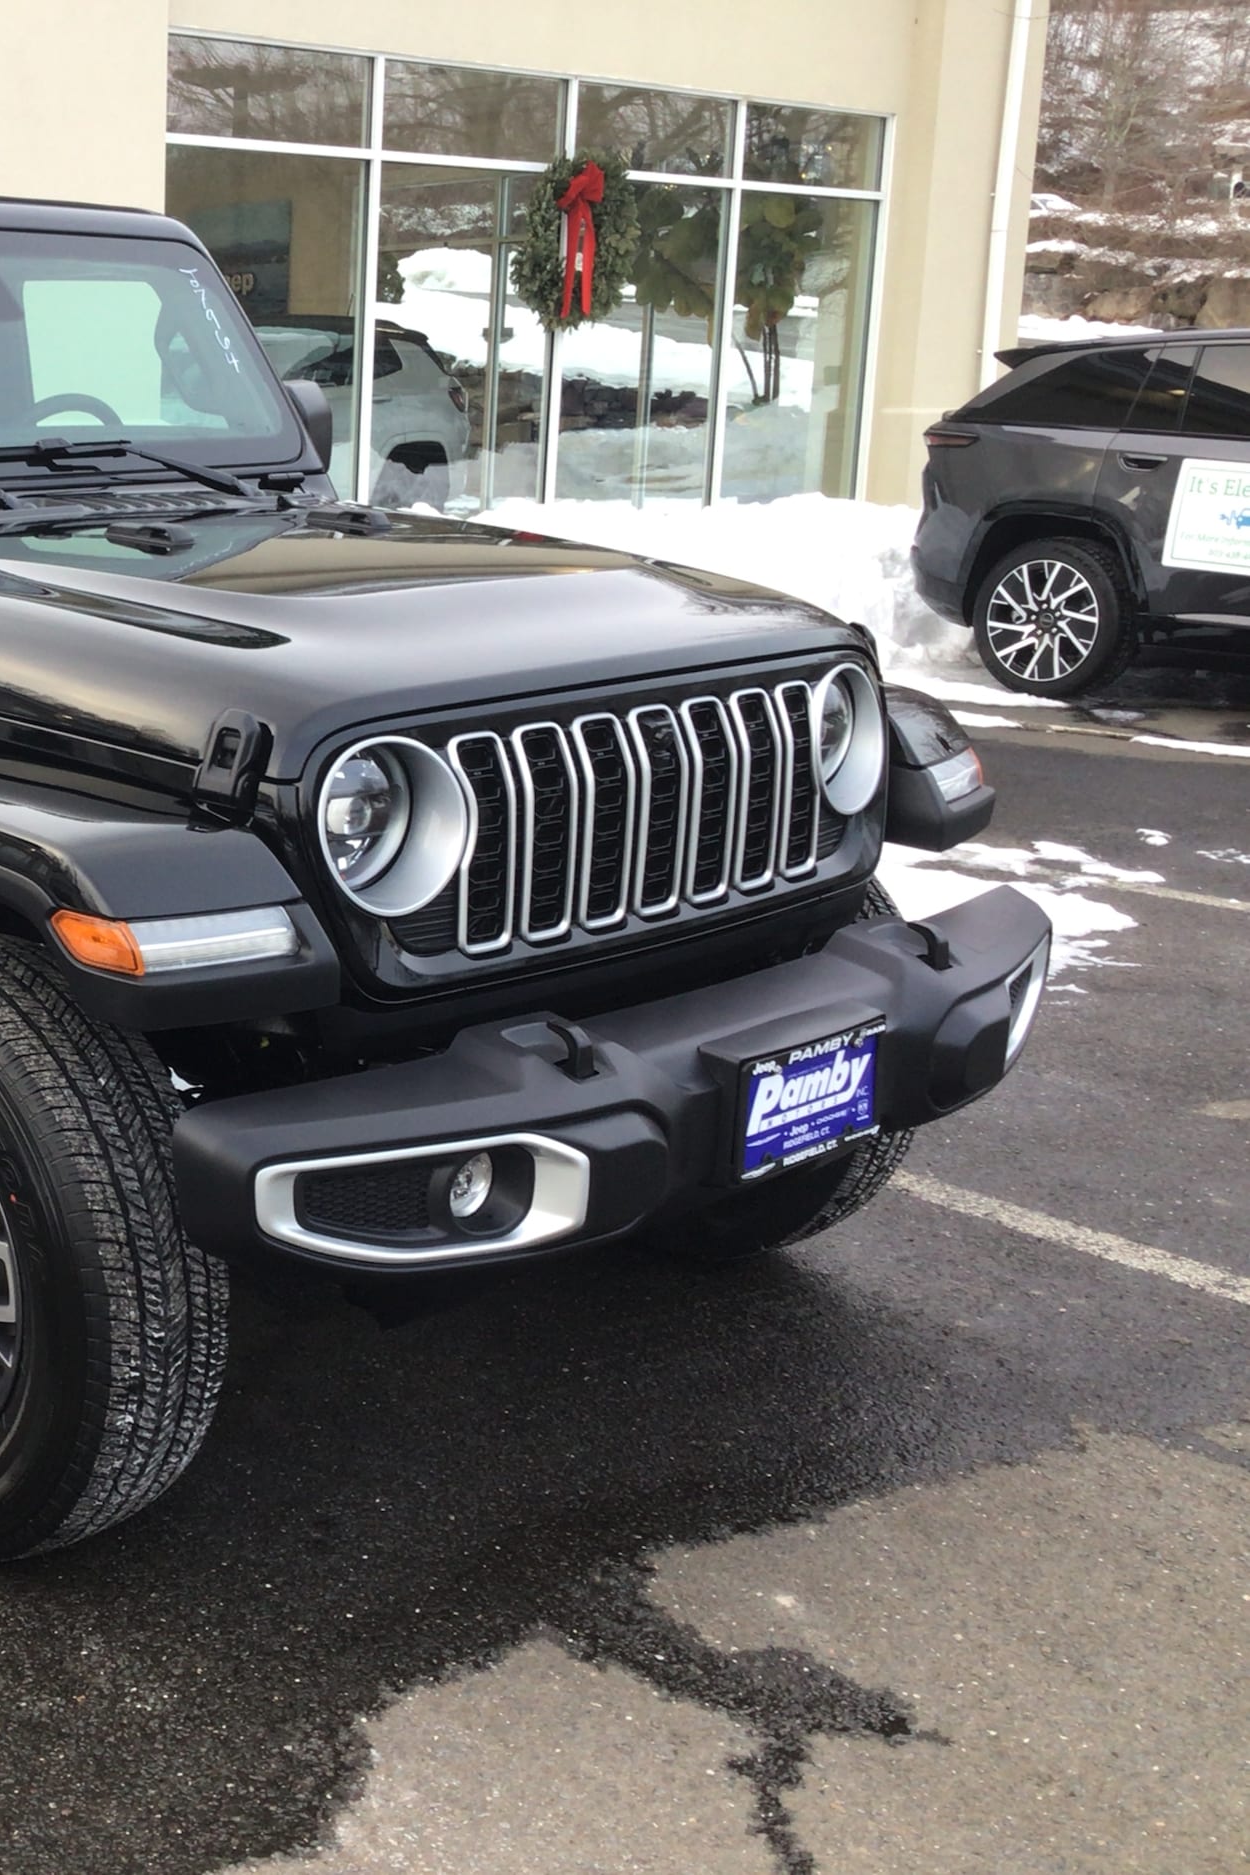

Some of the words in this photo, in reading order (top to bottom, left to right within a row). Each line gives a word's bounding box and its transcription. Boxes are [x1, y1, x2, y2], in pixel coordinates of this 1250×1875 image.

[225, 273, 255, 295] ep
[1189, 476, 1219, 495] It's
[788, 1032, 854, 1066] PAMBY
[746, 1050, 872, 1137] Pamby
[789, 1123, 809, 1137] Jeep
